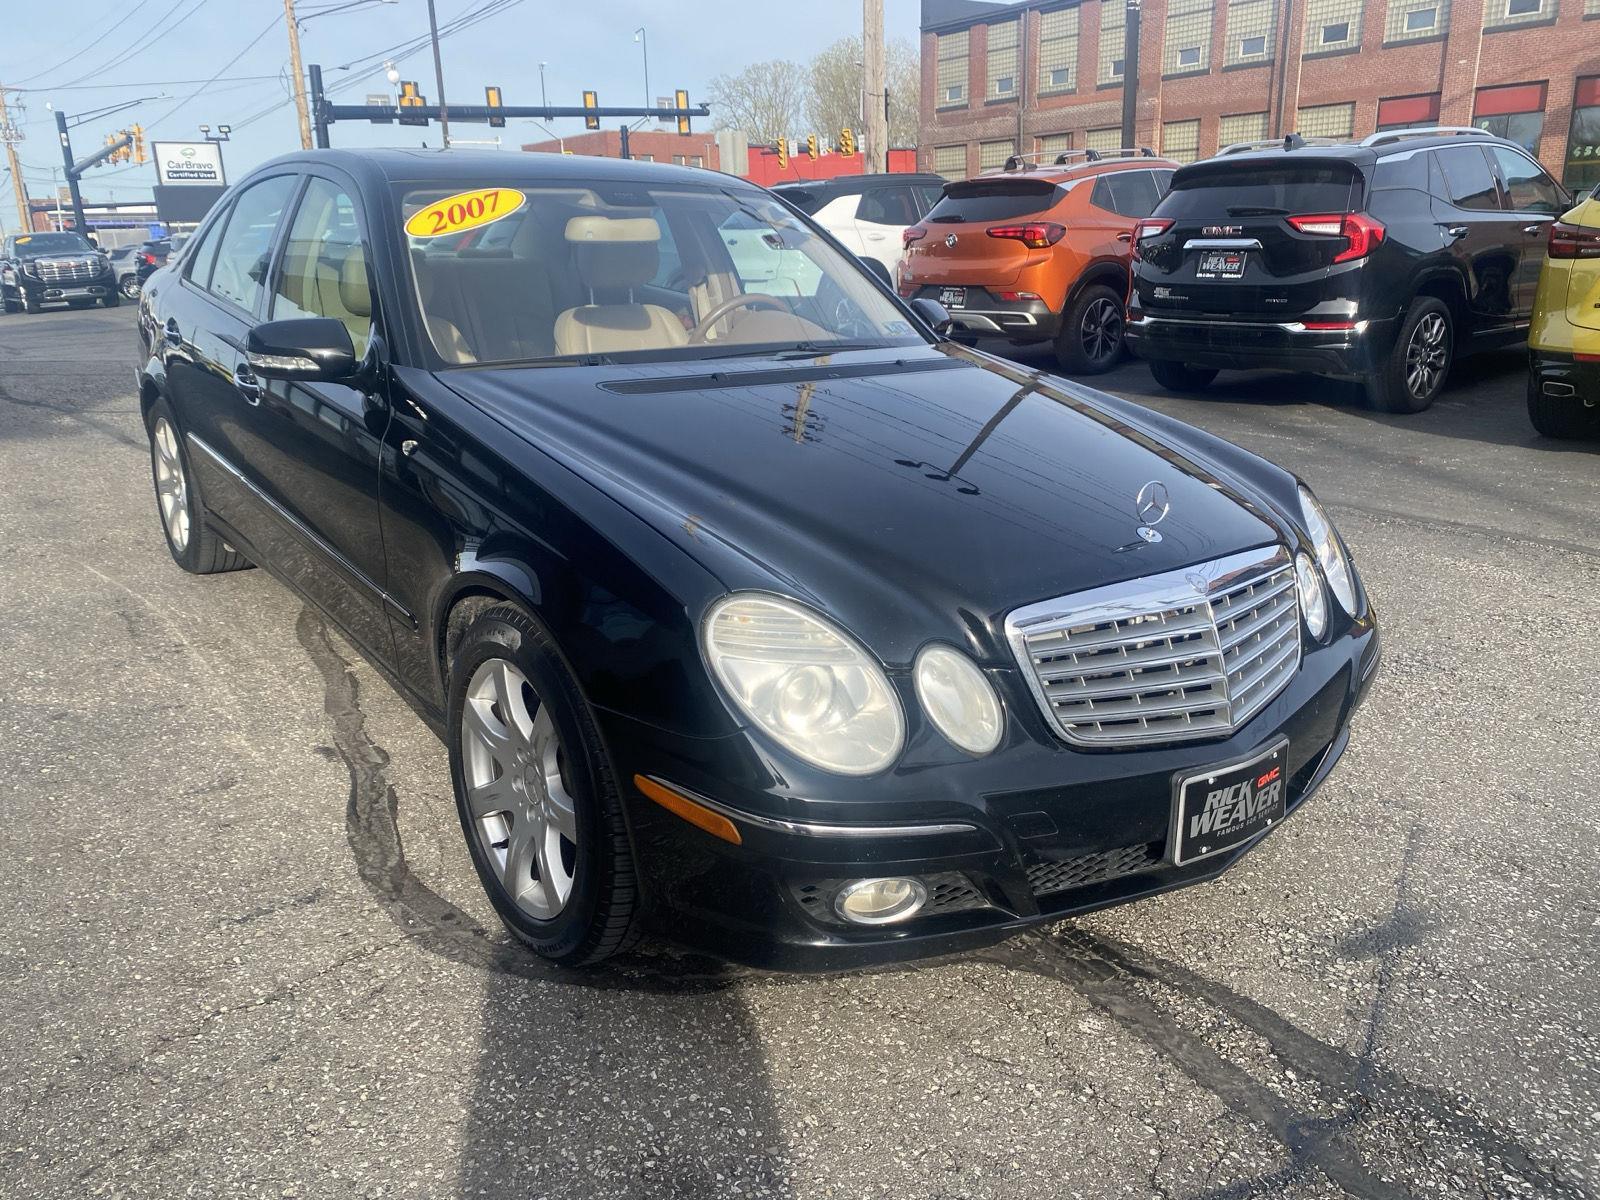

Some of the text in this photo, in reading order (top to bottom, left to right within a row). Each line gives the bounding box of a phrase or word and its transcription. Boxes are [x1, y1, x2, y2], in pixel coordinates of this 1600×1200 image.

[167, 160, 213, 169] CarBravo
[428, 191, 499, 234] 2007
[1202, 225, 1242, 236] GMC
[1202, 262, 1240, 270] WEAVER
[1257, 767, 1280, 788] GMC
[1203, 777, 1254, 812] RICK
[1190, 779, 1282, 838] WEAVER
[1216, 822, 1244, 837] FAMOUS
[1246, 816, 1257, 825] FOR
